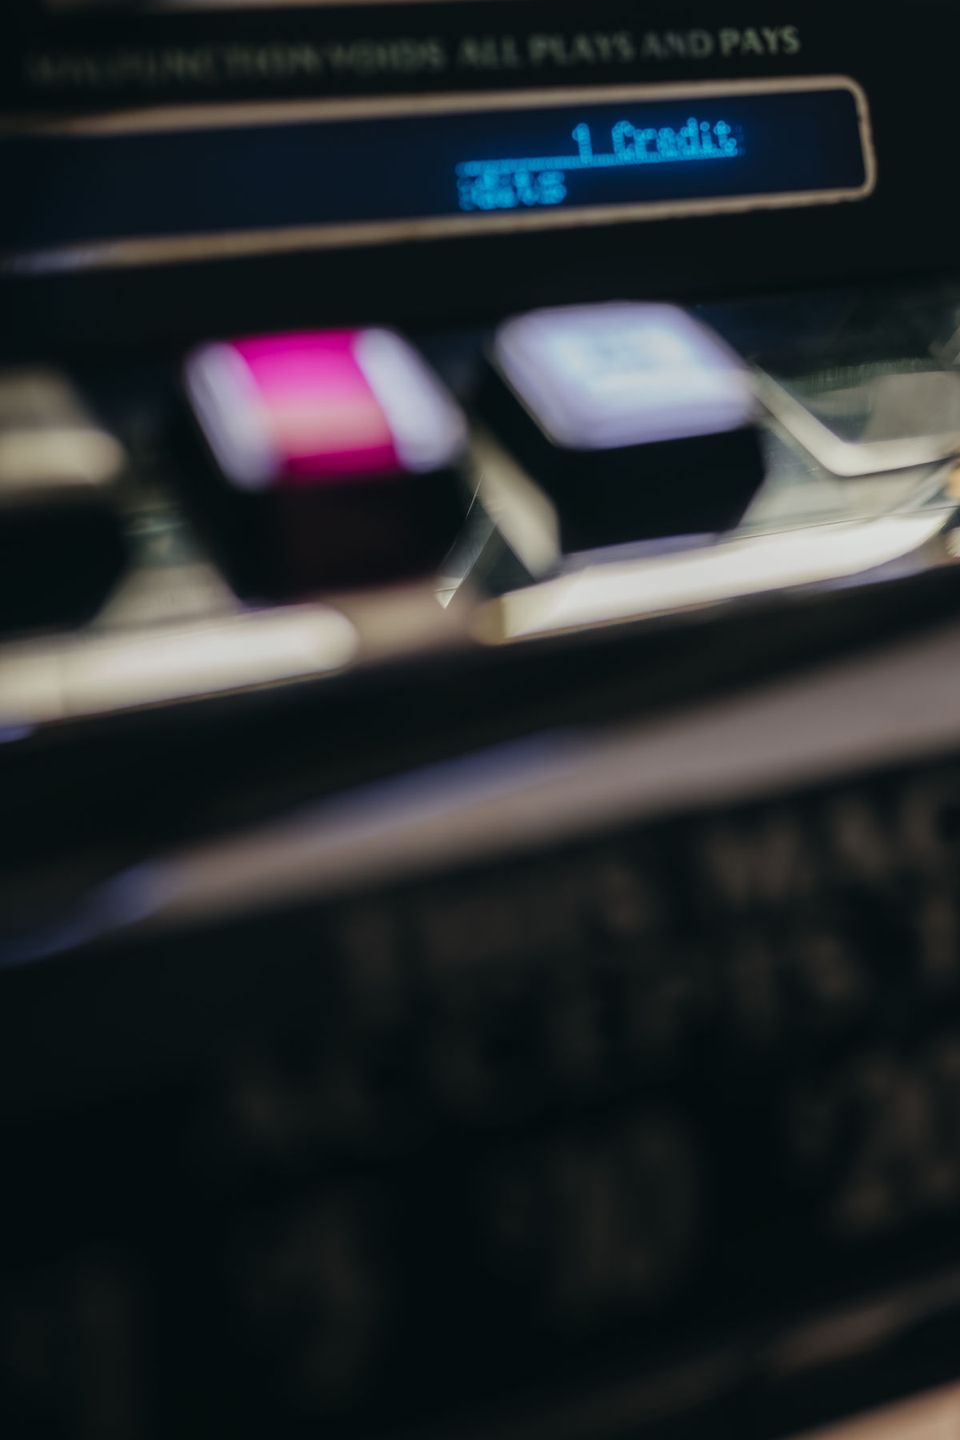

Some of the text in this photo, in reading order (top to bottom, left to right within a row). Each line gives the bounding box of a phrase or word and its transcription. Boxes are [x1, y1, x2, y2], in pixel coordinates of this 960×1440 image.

[525, 30, 637, 68] PLAYS
[640, 27, 714, 59] AND
[717, 23, 801, 56] PAYS
